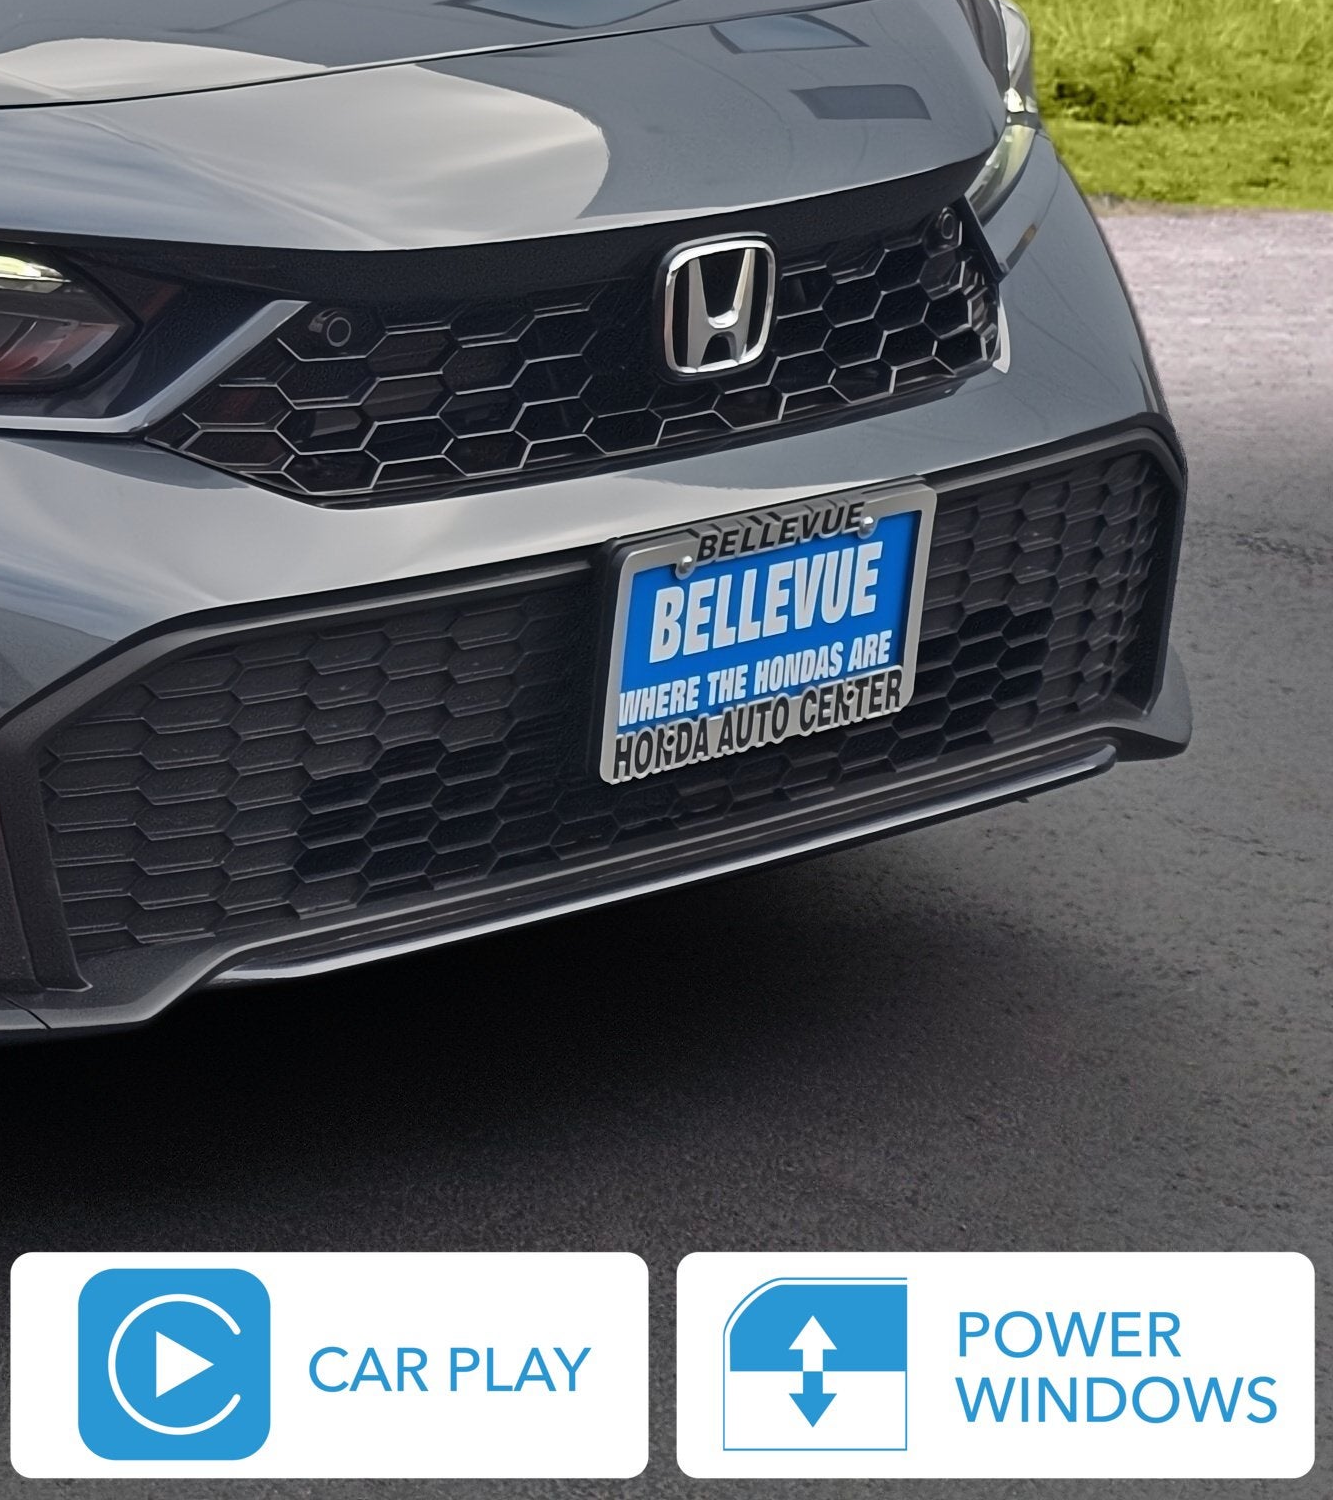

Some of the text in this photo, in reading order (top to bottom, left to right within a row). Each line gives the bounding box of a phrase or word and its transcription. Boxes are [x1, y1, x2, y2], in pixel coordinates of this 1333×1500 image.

[695, 501, 865, 562] BELLEVUE
[648, 540, 883, 664] BELLEVUE
[612, 671, 903, 780] HONDA AUTO CENTER
[618, 629, 893, 727] WHERE THE HONDAS ARE
